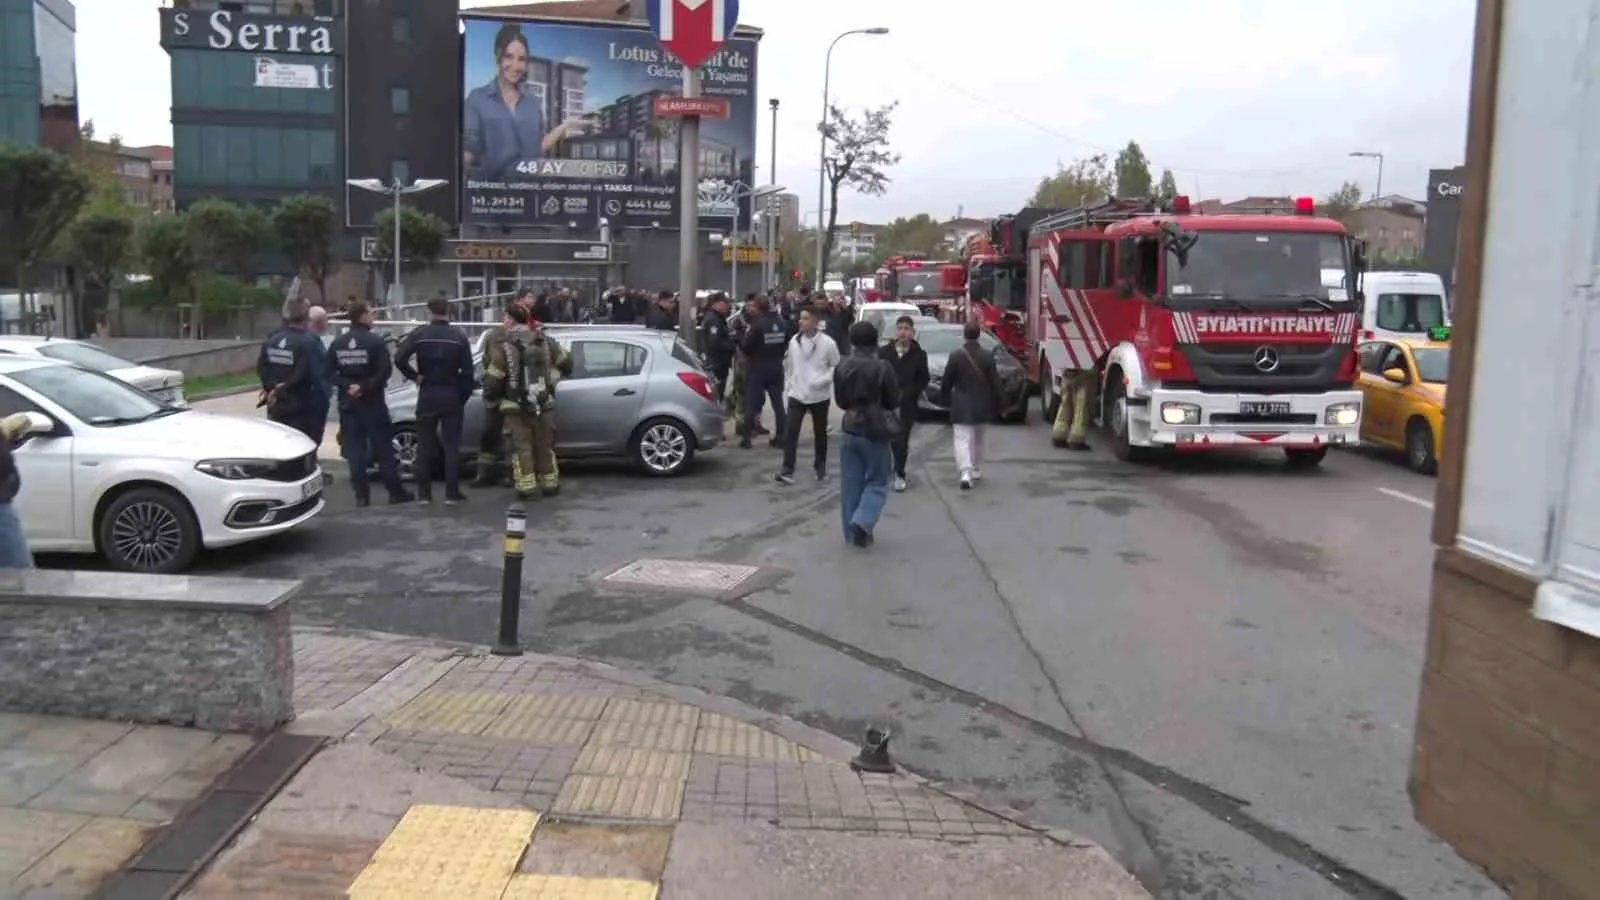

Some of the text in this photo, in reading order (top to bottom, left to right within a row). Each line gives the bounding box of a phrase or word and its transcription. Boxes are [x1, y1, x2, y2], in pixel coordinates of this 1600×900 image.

[208, 10, 333, 53] Serra
[608, 42, 658, 62] Lotus
[515, 160, 538, 174] 48
[541, 161, 563, 174] AY
[604, 184, 633, 192] TAKAS
[1270, 316, 1335, 332] İTFAİYE
